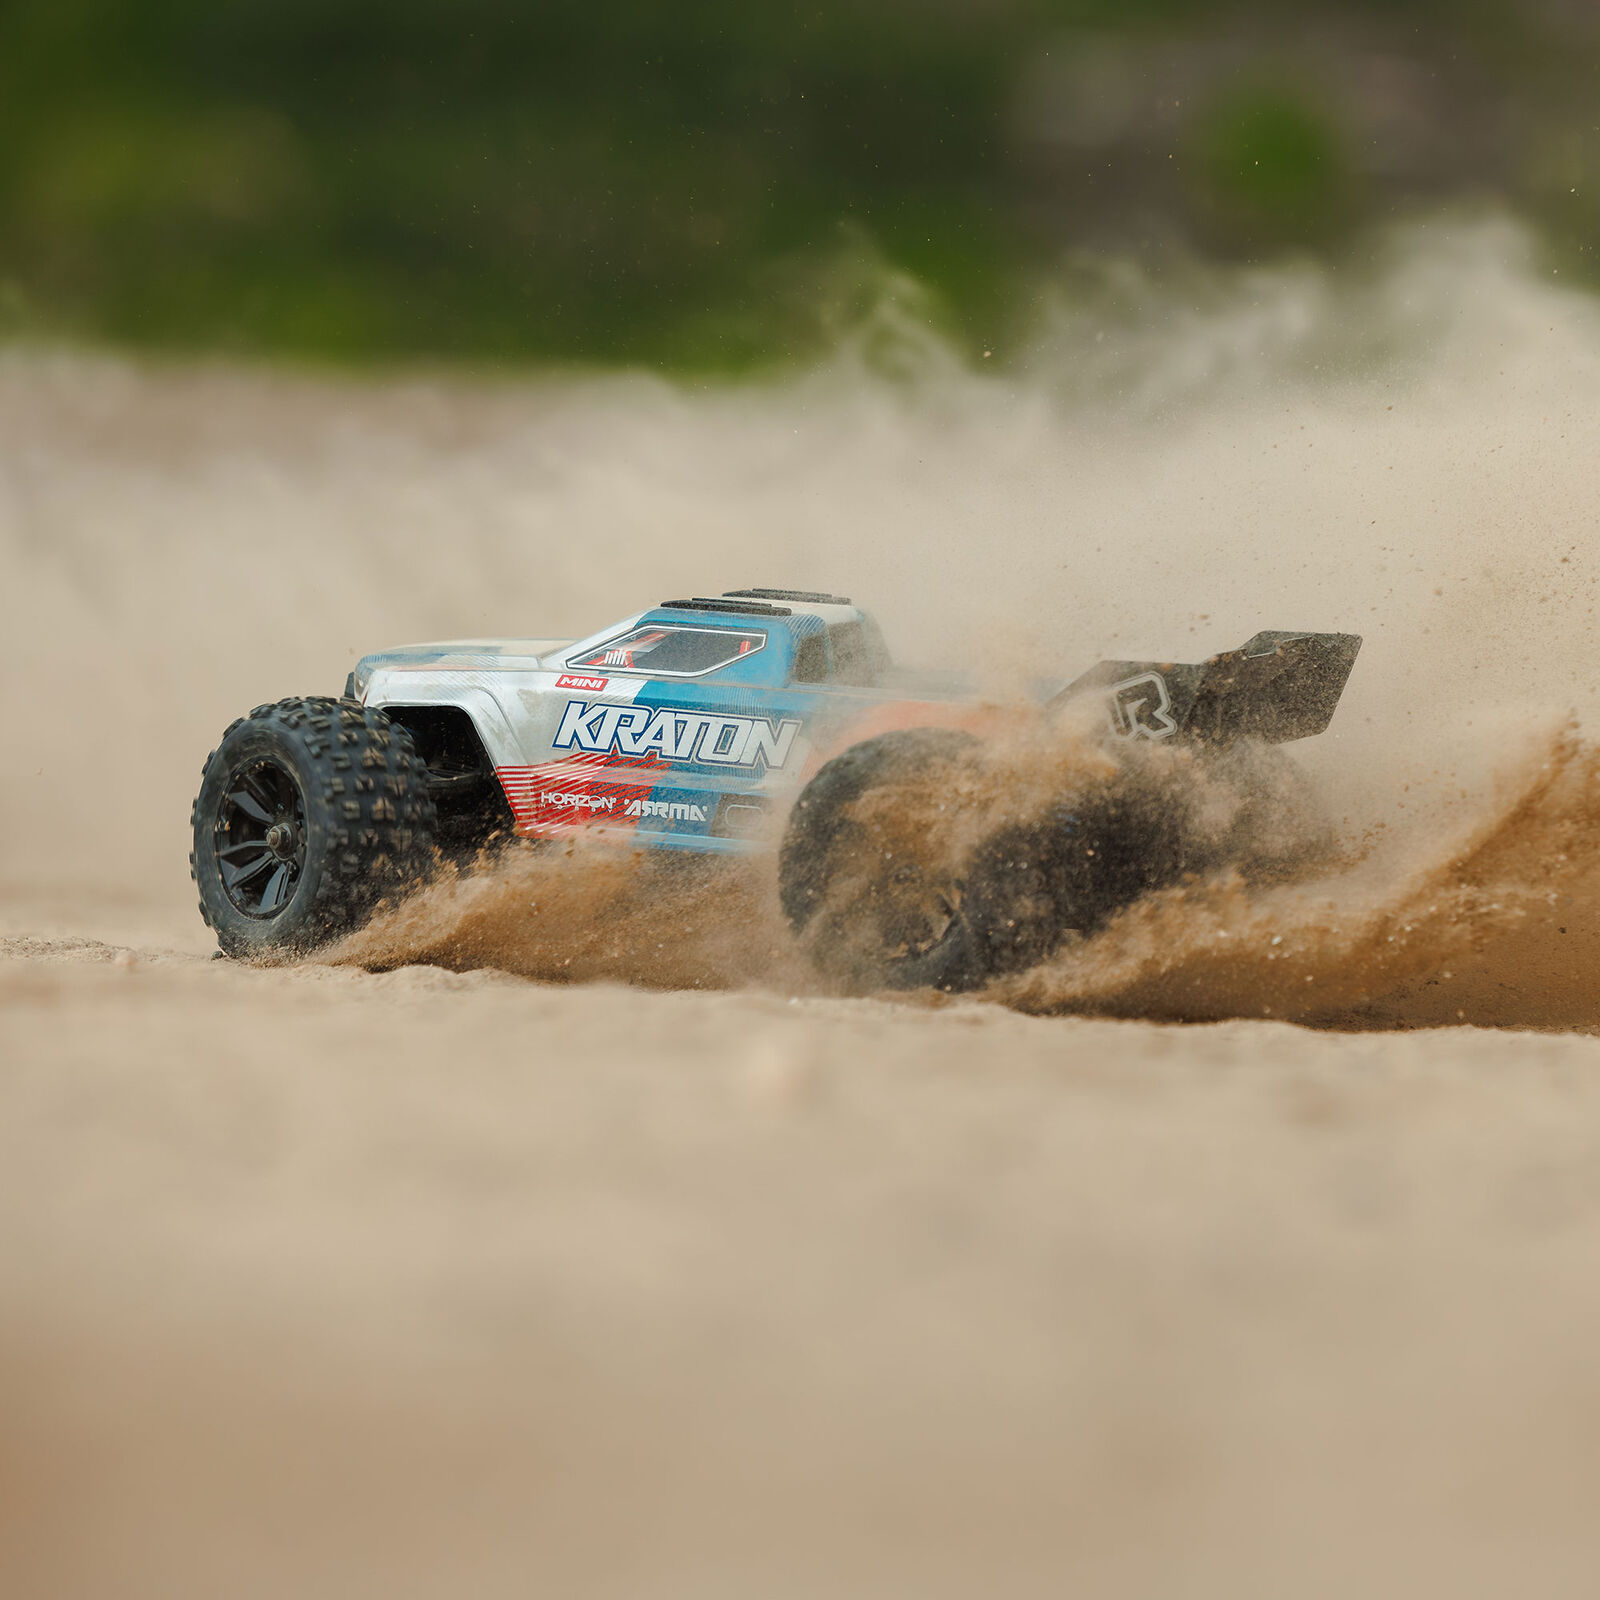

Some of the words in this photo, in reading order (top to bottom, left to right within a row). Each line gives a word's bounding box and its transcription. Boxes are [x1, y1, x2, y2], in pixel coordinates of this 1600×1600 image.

[560, 676, 603, 689] MINI
[552, 700, 802, 770] KRATON
[541, 791, 617, 809] HORIZON
